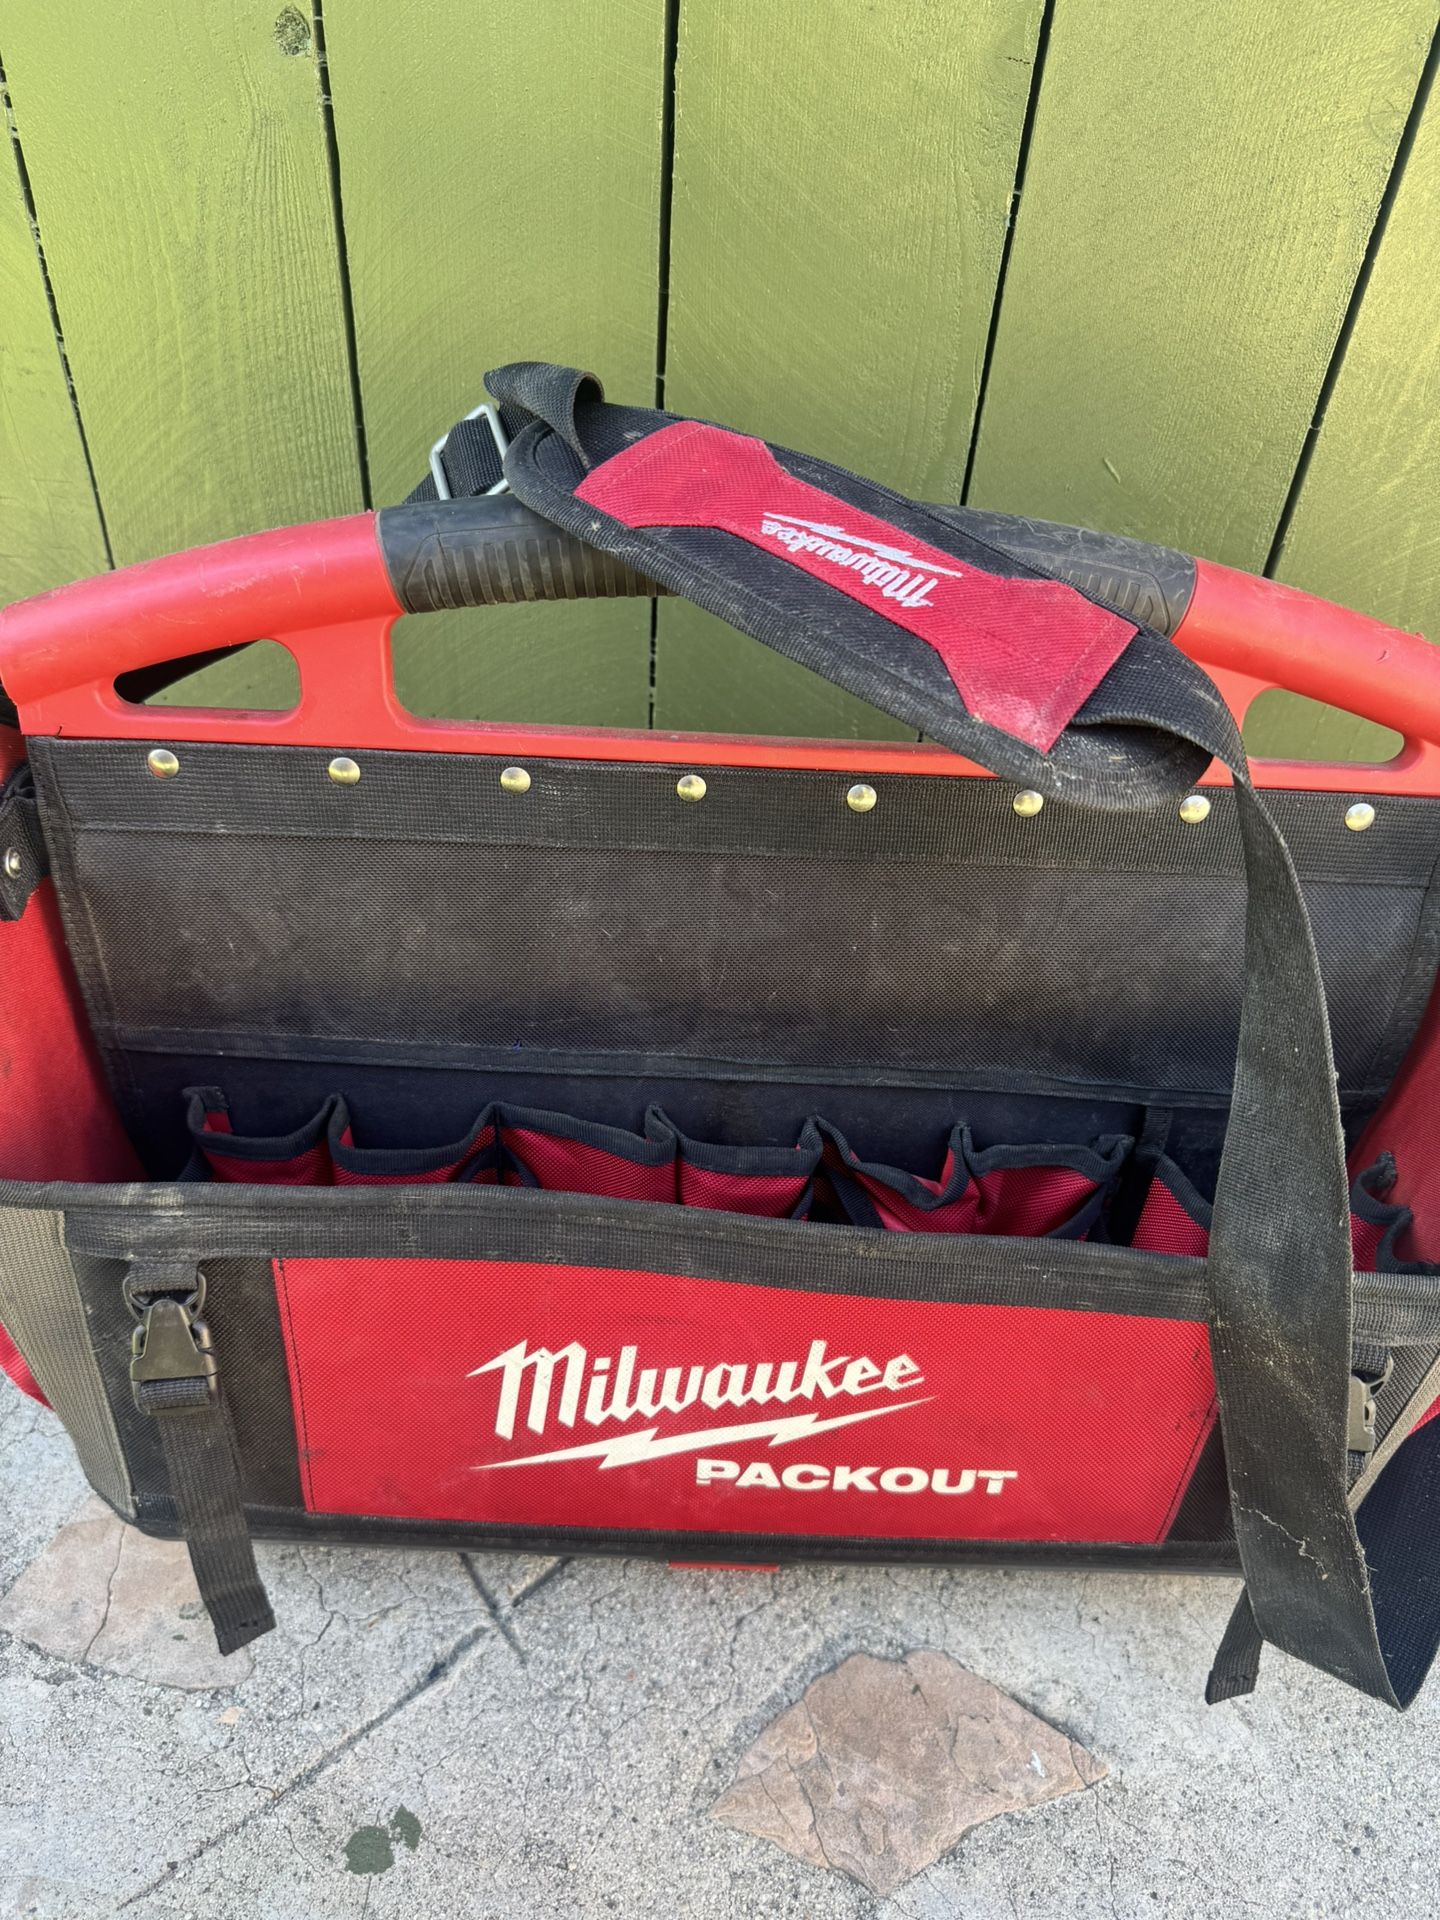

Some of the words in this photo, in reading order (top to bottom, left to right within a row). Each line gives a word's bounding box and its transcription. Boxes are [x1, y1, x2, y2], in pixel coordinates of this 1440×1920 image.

[761, 519, 939, 608] Milwaukee
[465, 1338, 925, 1441] Milwaukee
[695, 1457, 1019, 1495] PACKOUT
